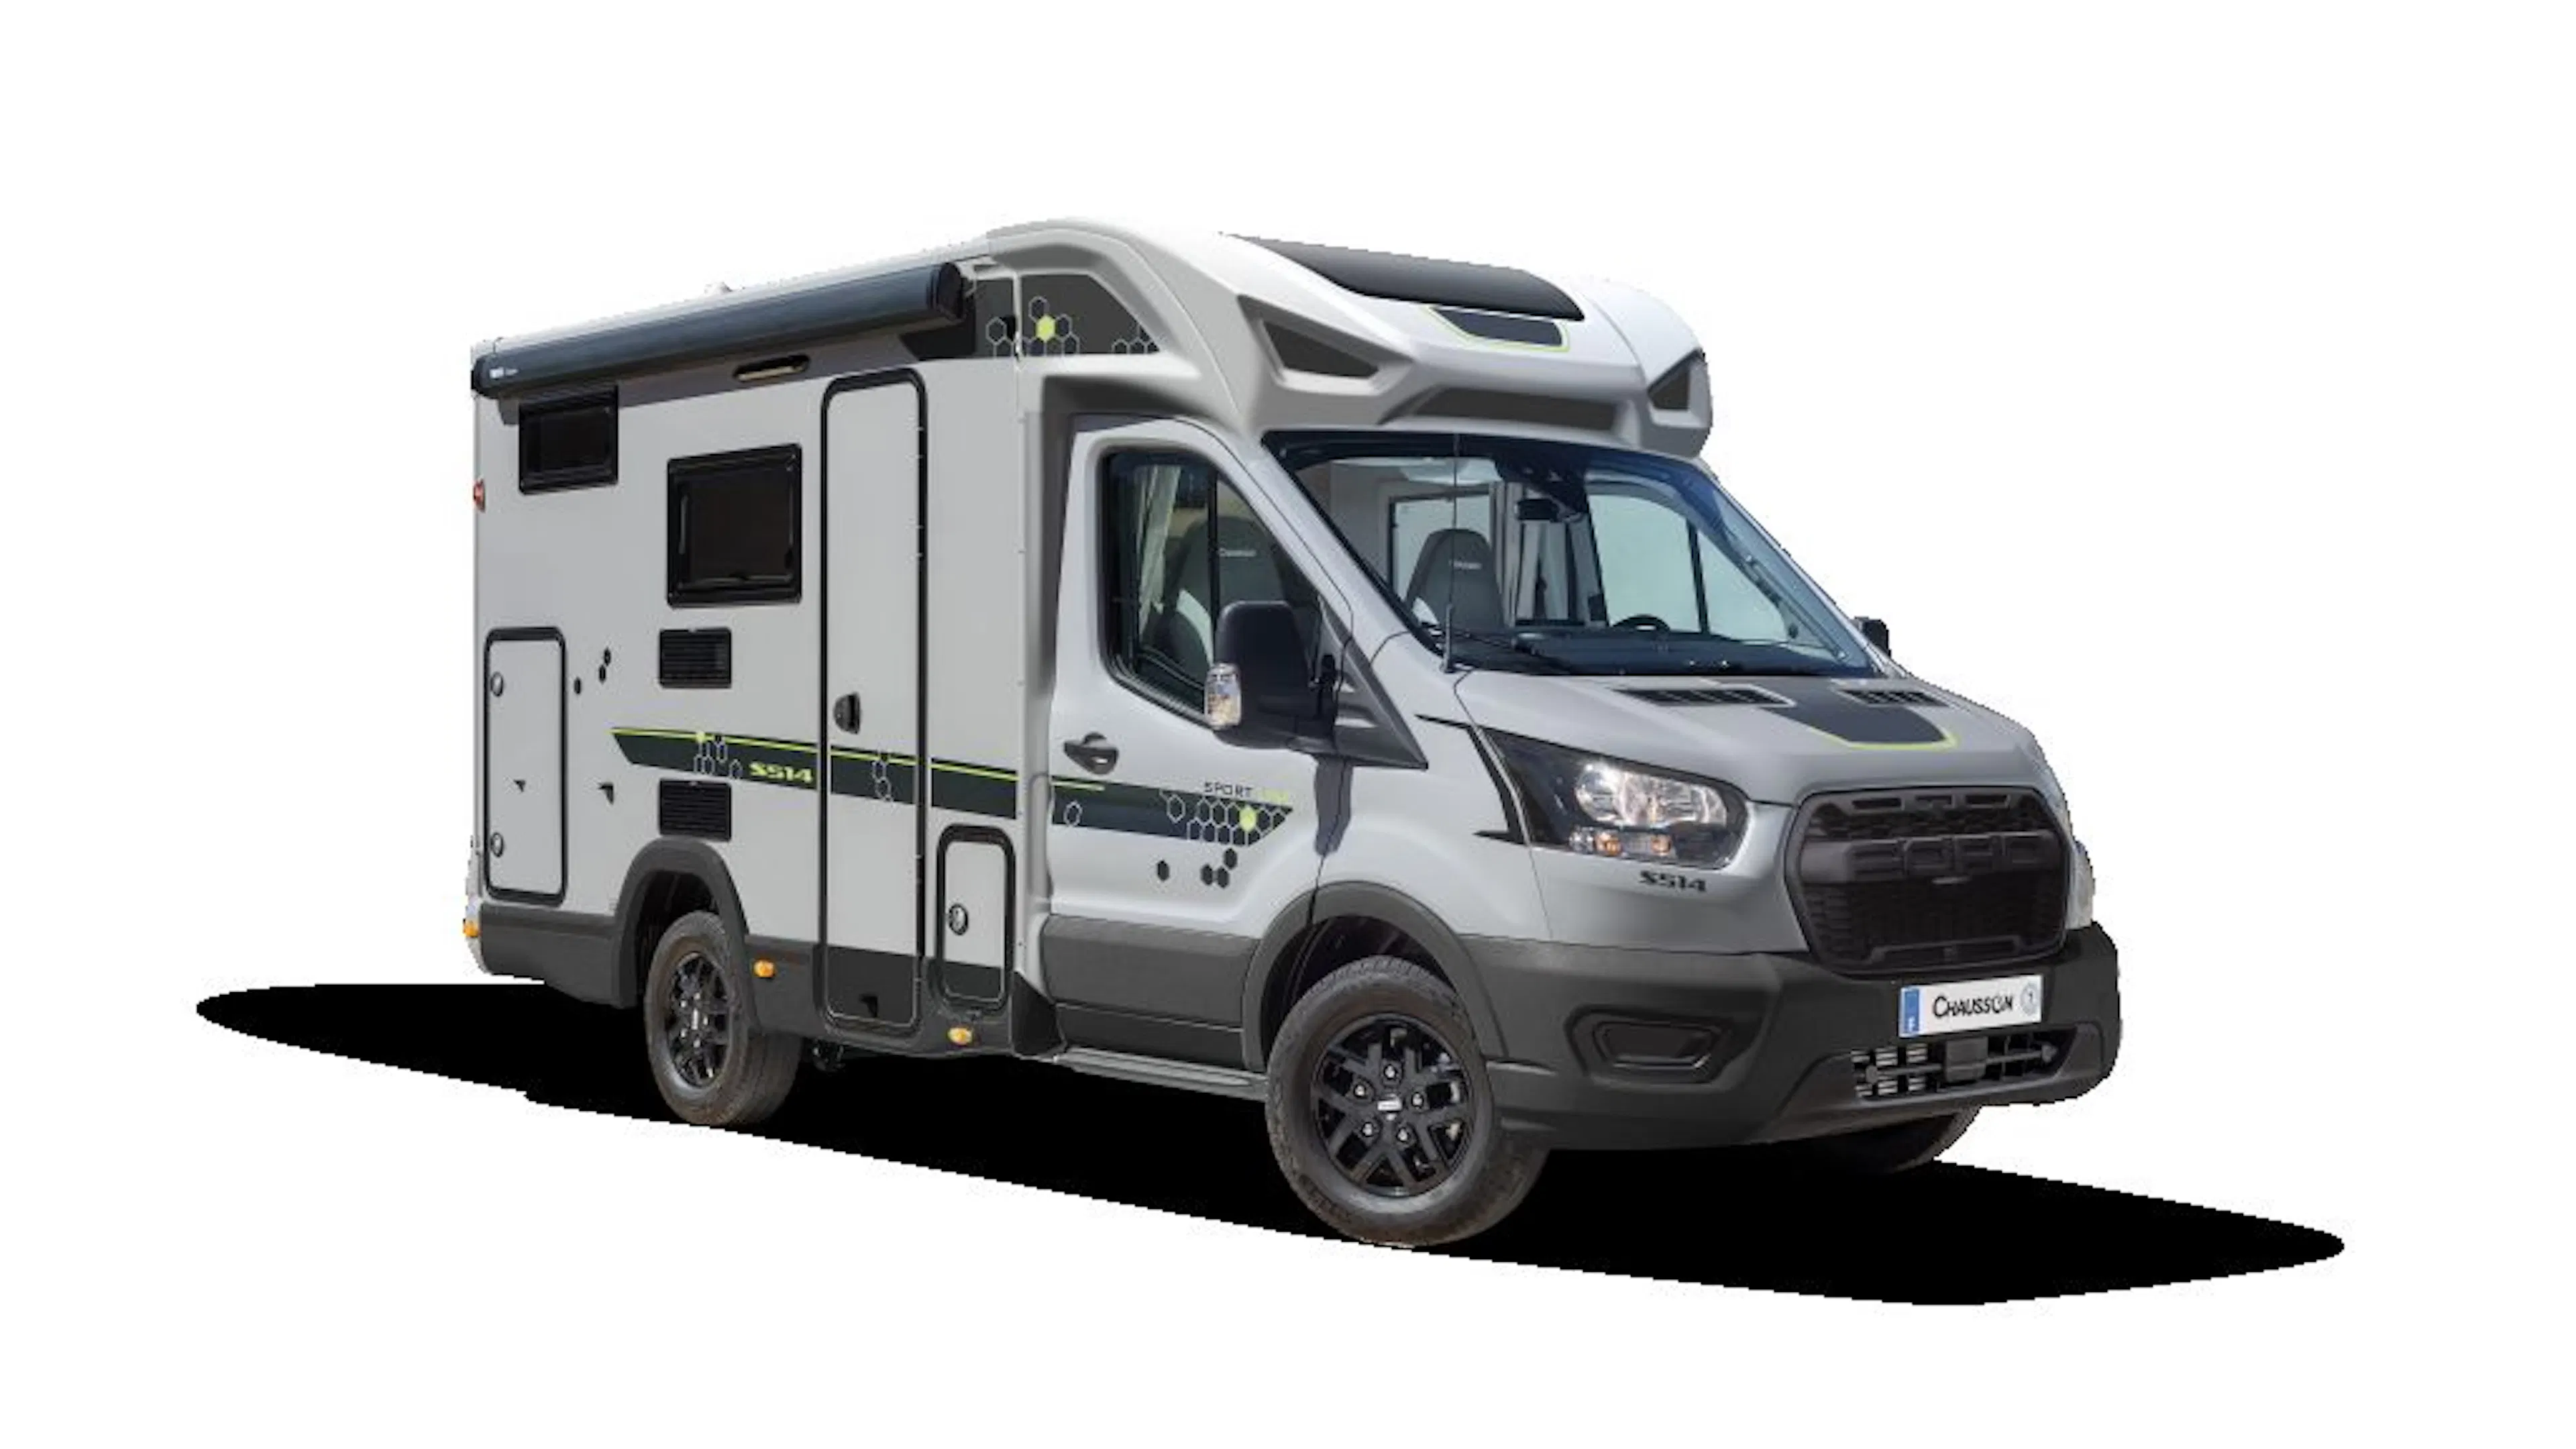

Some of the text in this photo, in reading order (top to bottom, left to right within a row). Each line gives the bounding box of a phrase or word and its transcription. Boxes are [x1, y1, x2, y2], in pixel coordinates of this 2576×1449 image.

[748, 760, 813, 784] S514
[1204, 782, 1254, 798] SPORT
[1639, 870, 1707, 893] S514
